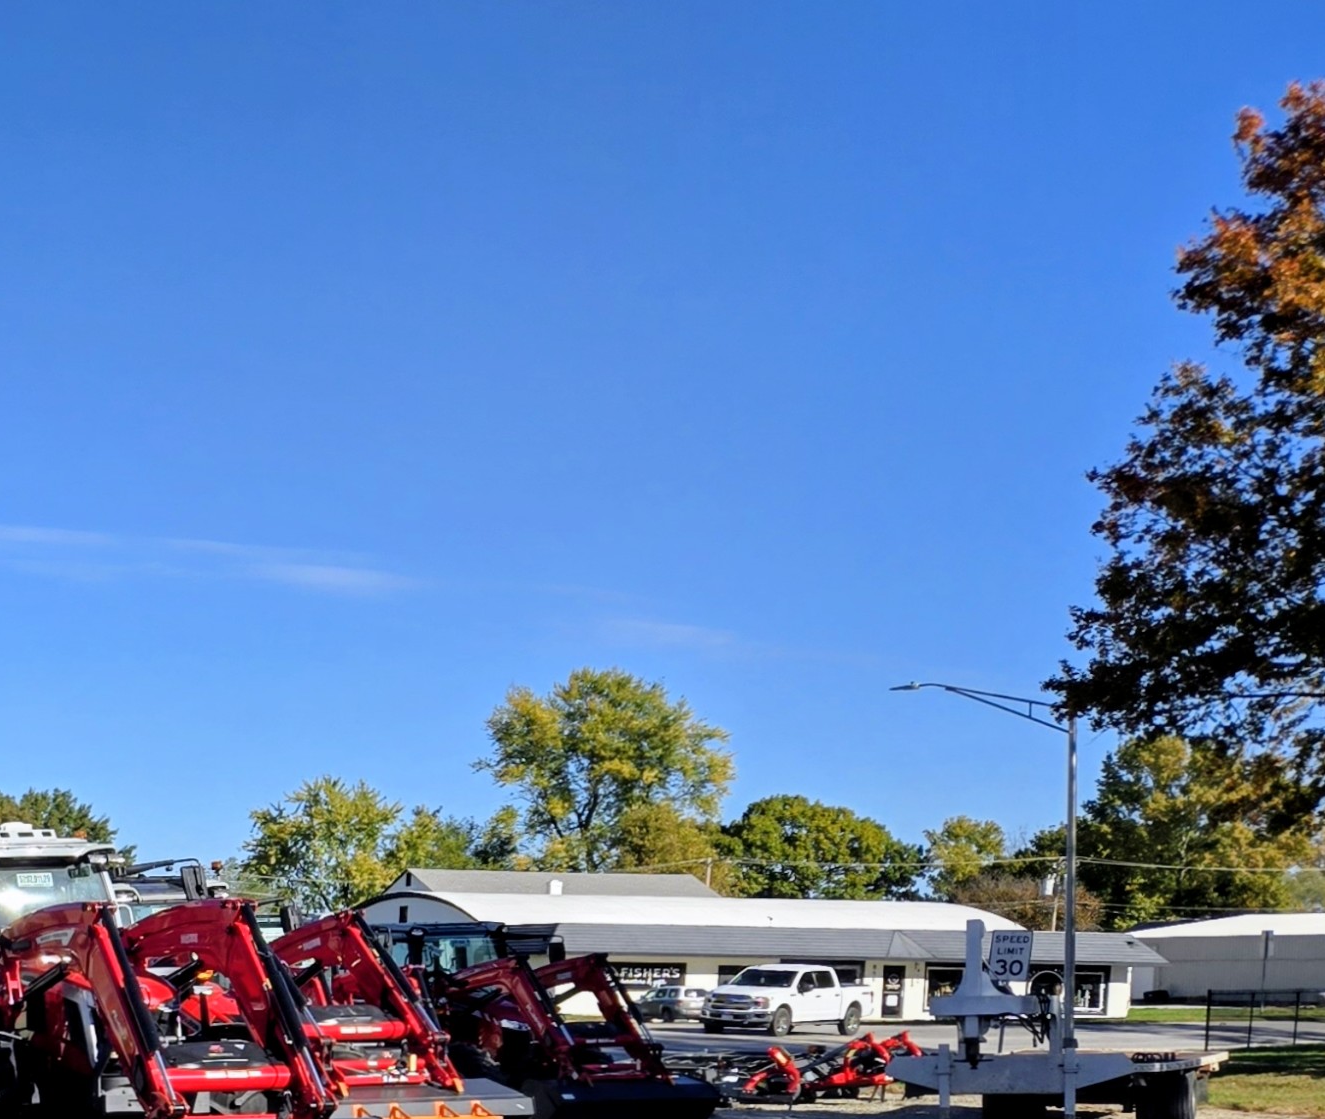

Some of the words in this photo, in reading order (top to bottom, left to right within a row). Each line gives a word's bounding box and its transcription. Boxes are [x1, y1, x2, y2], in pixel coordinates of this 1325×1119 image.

[995, 935, 1029, 944] SPEED
[997, 947, 1024, 956] LIMIT
[994, 959, 1024, 976] 30
